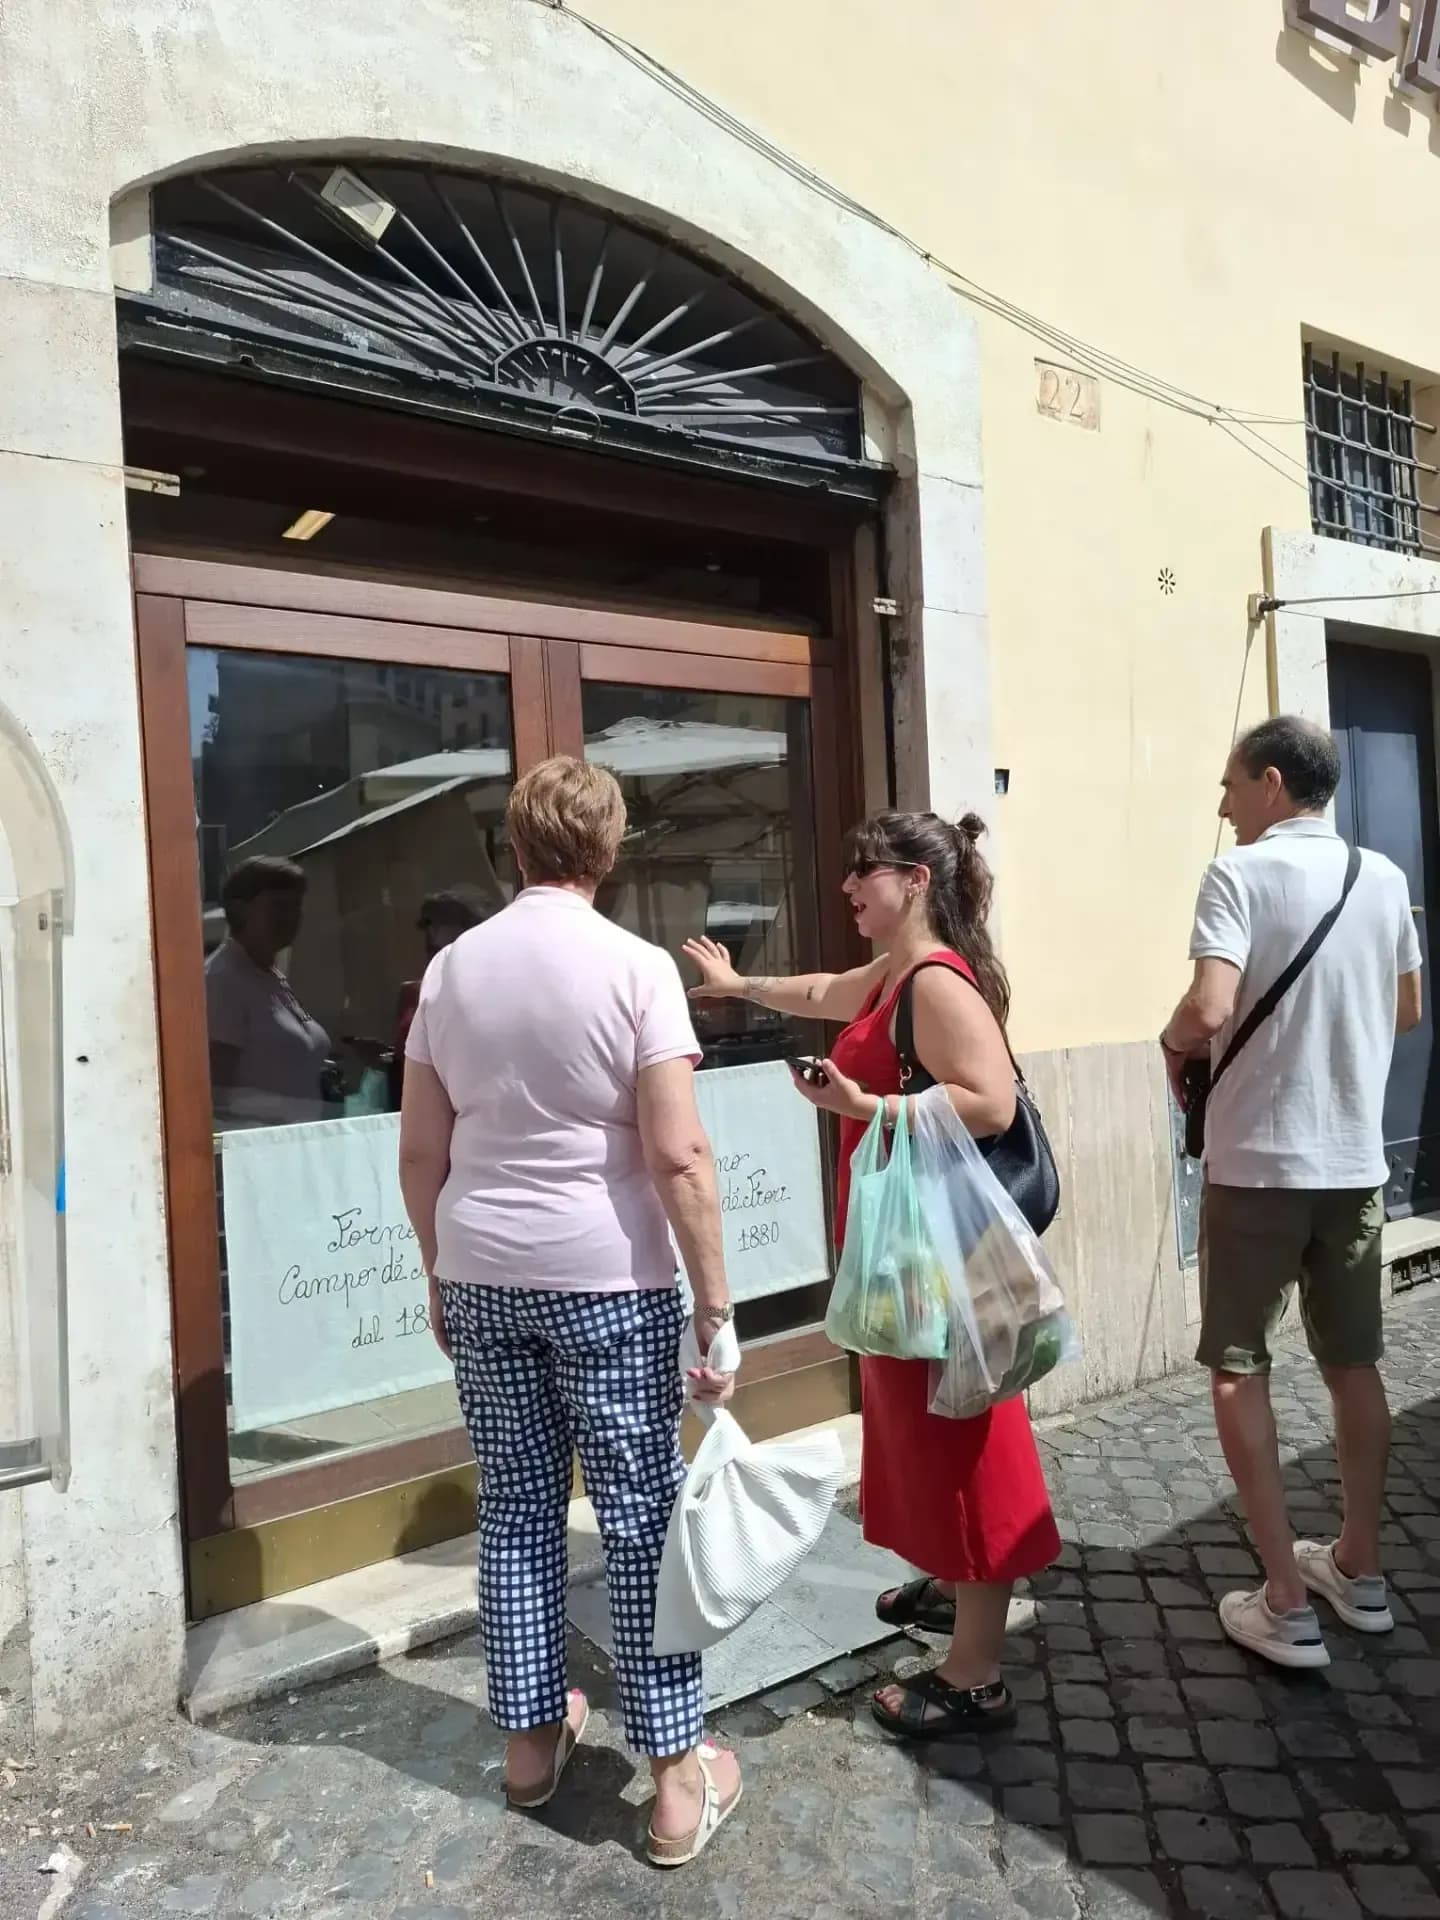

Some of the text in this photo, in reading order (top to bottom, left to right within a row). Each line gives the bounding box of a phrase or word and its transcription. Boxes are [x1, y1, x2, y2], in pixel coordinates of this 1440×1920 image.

[1042, 369, 1085, 419] 22
[742, 1167, 791, 1208] Fiori
[737, 1221, 779, 1252] 1880
[279, 1264, 377, 1308] Campo
[352, 1303, 434, 1348] dal 18
